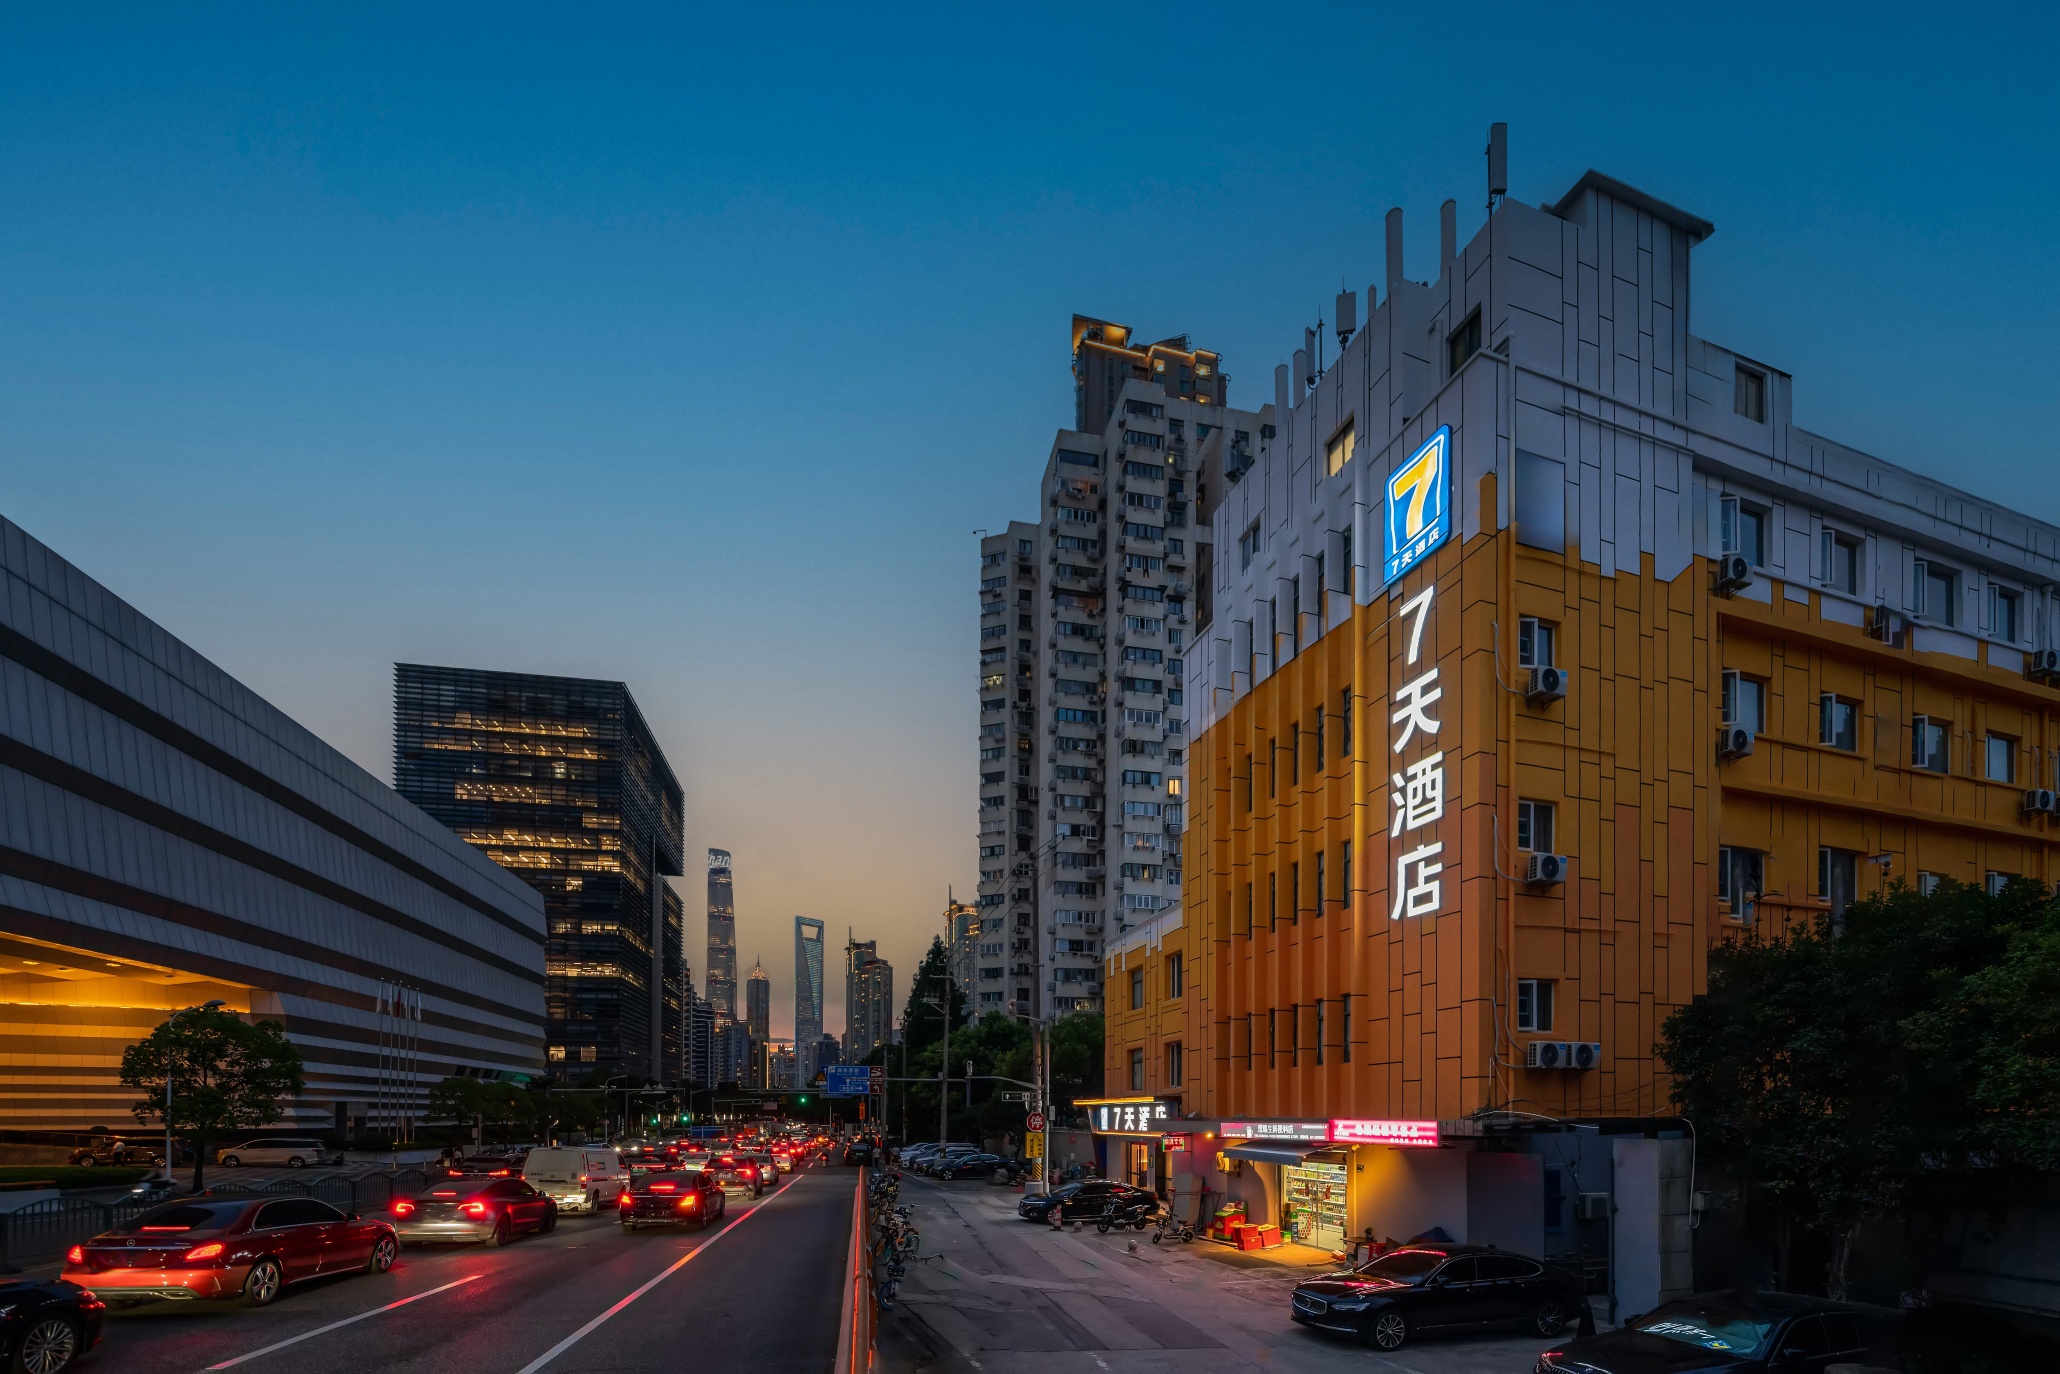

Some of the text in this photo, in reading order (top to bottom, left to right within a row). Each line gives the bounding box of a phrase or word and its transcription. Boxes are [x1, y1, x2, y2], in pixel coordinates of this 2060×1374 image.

[1394, 445, 1438, 540] 7
[1391, 526, 1440, 576] 7天酒店
[1390, 585, 1444, 921] 7天酒店
[708, 853, 729, 866] han
[1030, 1115, 1043, 1129] 停
